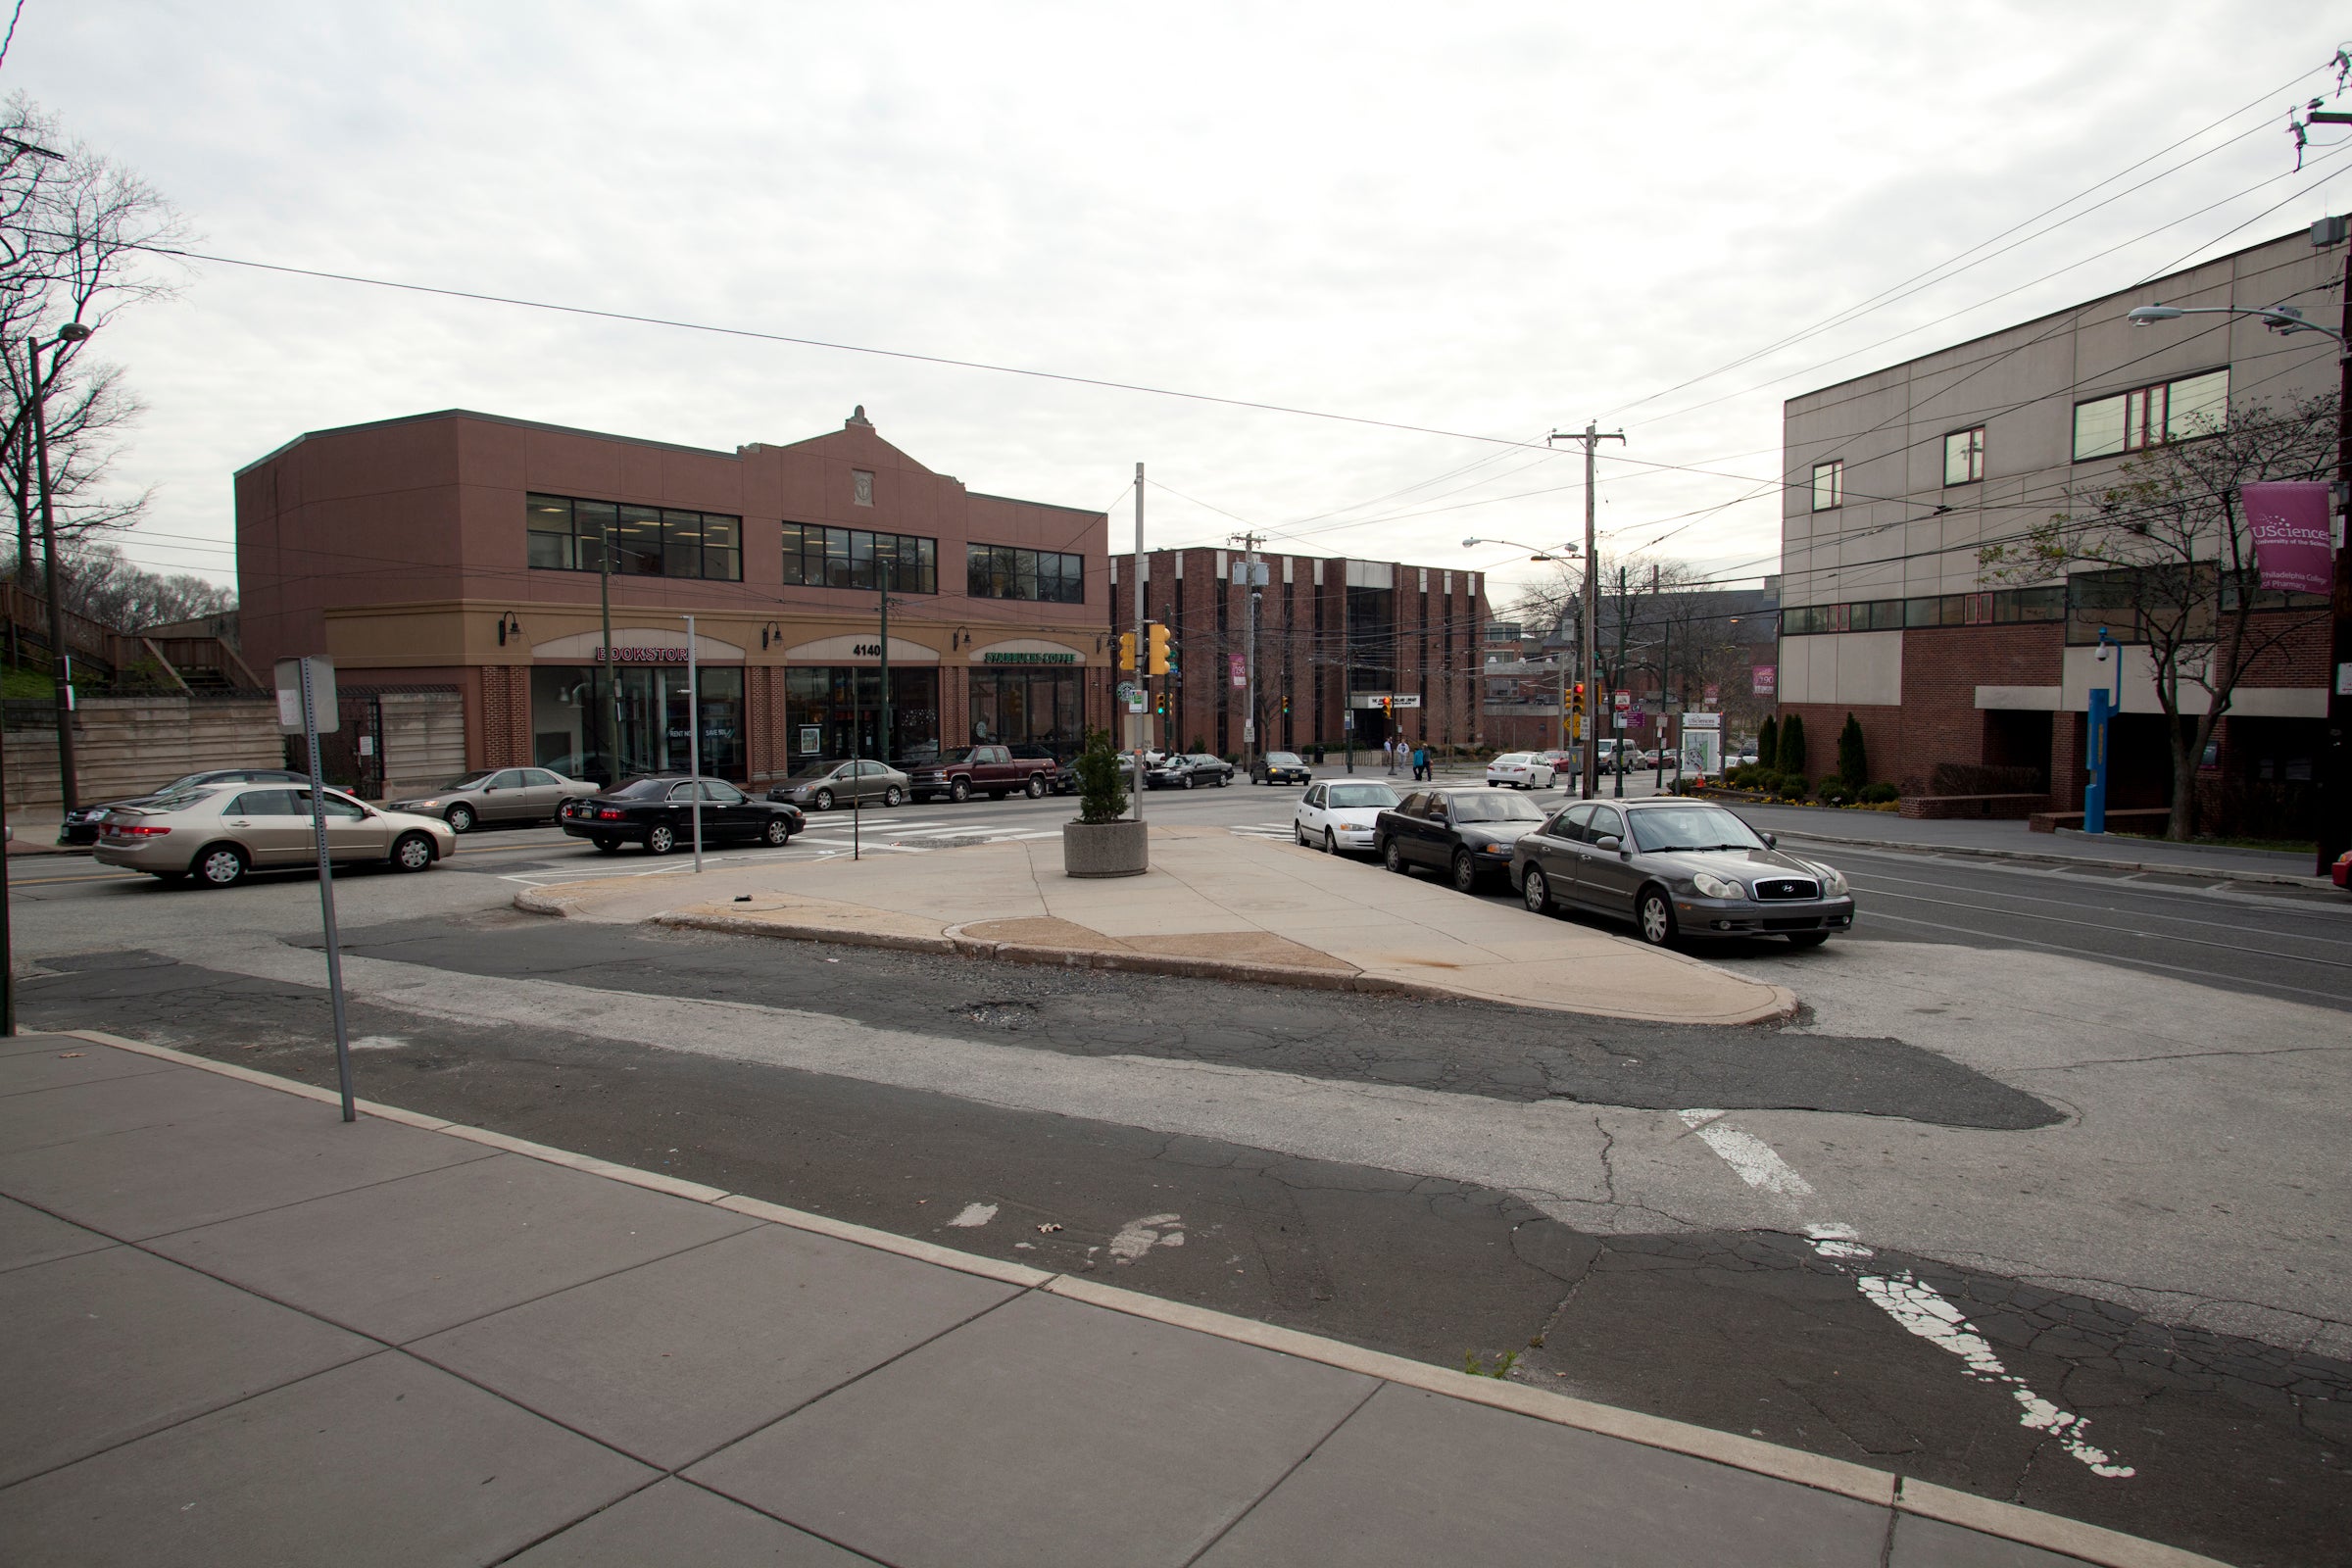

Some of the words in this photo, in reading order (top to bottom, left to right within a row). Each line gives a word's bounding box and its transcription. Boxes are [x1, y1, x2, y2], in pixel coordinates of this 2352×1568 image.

[2252, 525, 2329, 541] USciences
[2261, 571, 2306, 581] Philadelphia
[2272, 580, 2307, 591] Pharmacy
[596, 646, 698, 662] BOOKSTOR
[853, 644, 881, 657] 4140
[984, 653, 1043, 663] STARBUCKS
[1043, 654, 1076, 663] COFFEE
